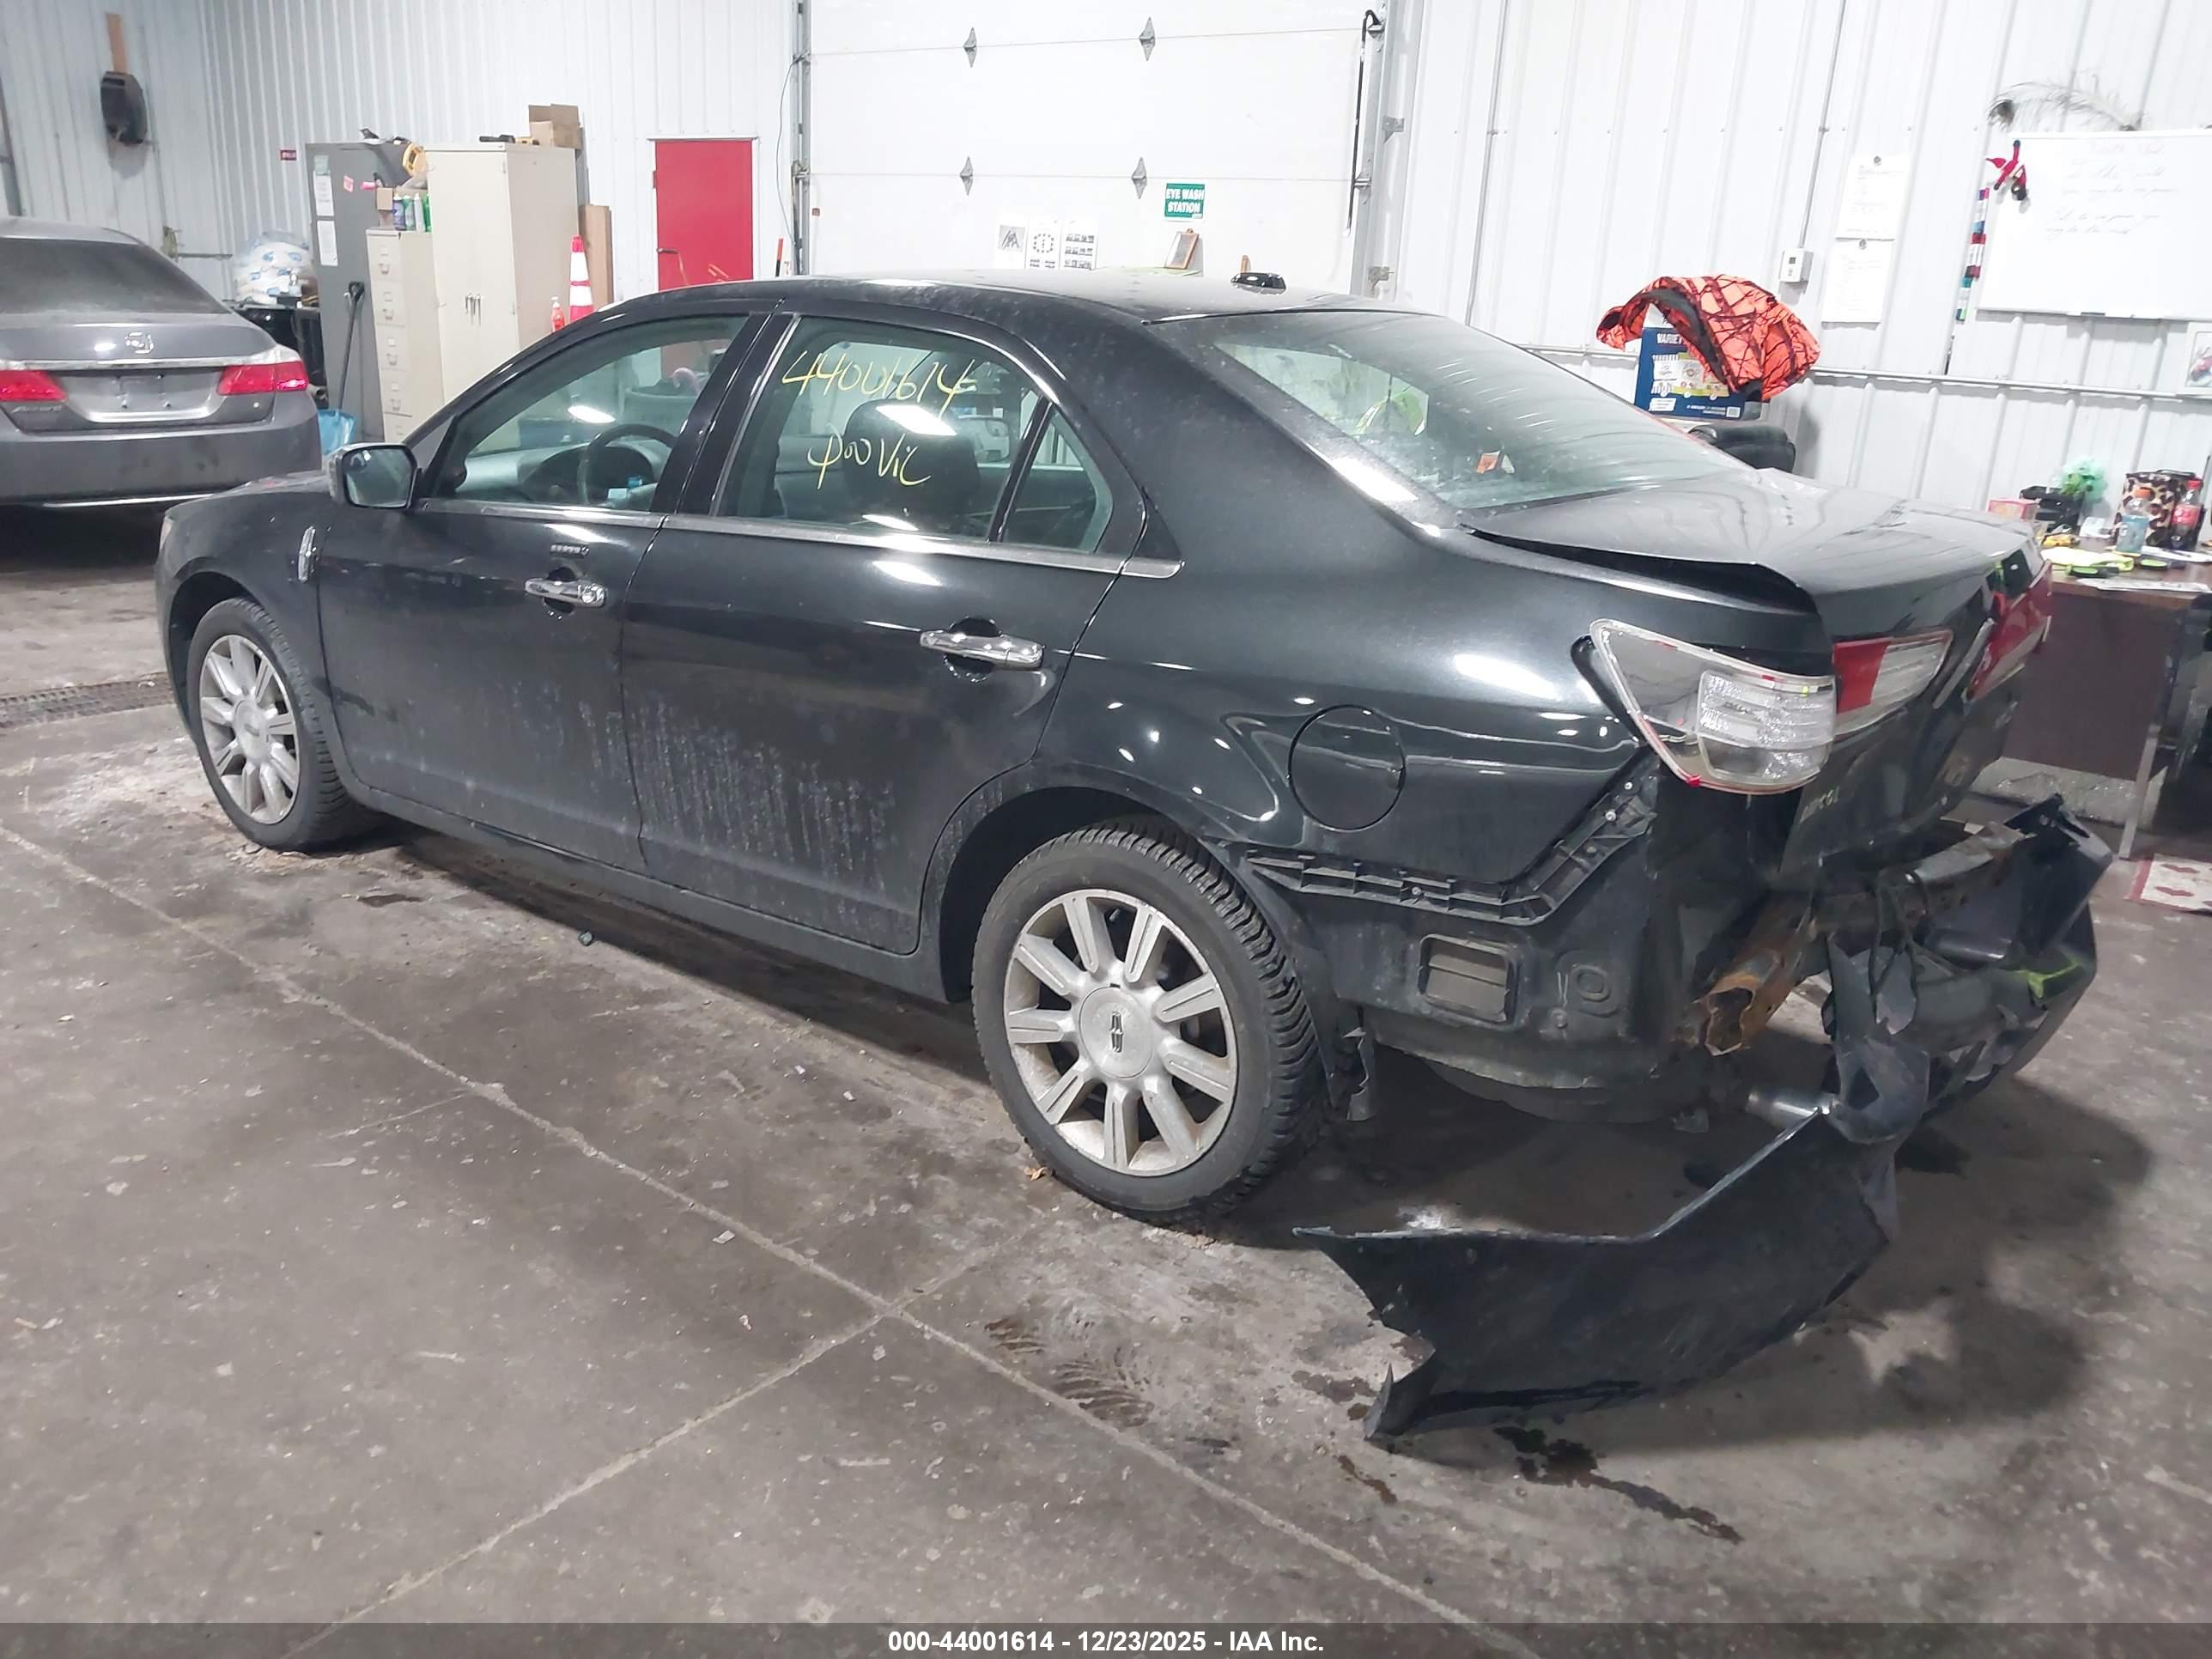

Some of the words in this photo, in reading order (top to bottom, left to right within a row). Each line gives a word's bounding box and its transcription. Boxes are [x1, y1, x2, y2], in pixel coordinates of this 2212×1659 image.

[1165, 188, 1181, 199] EYE
[1182, 188, 1205, 200] WASH
[1167, 201, 1200, 213] STATION
